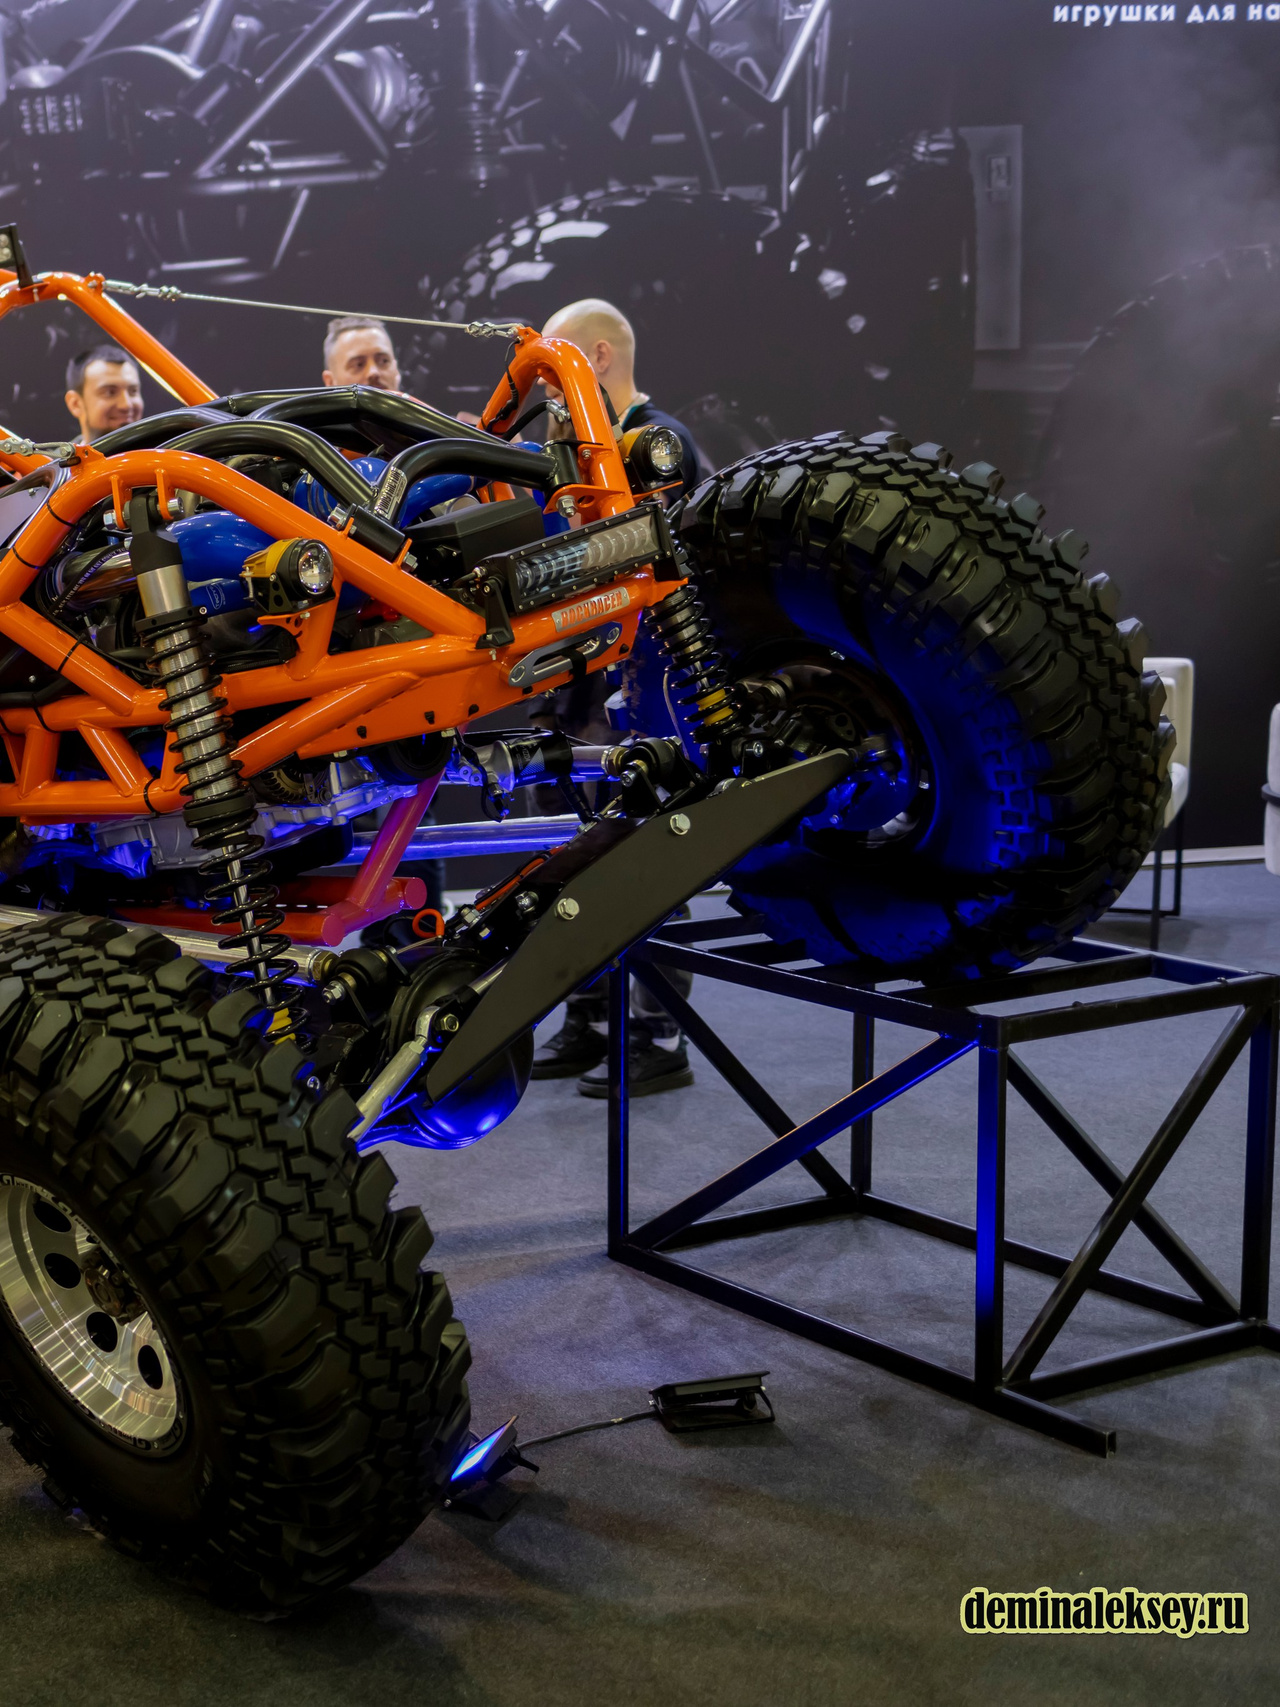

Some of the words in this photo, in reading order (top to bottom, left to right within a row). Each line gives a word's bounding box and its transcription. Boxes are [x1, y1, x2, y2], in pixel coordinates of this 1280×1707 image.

[1053, 3, 1176, 27] игрушки
[1186, 3, 1236, 24] для
[560, 591, 623, 628] ROCKRACER
